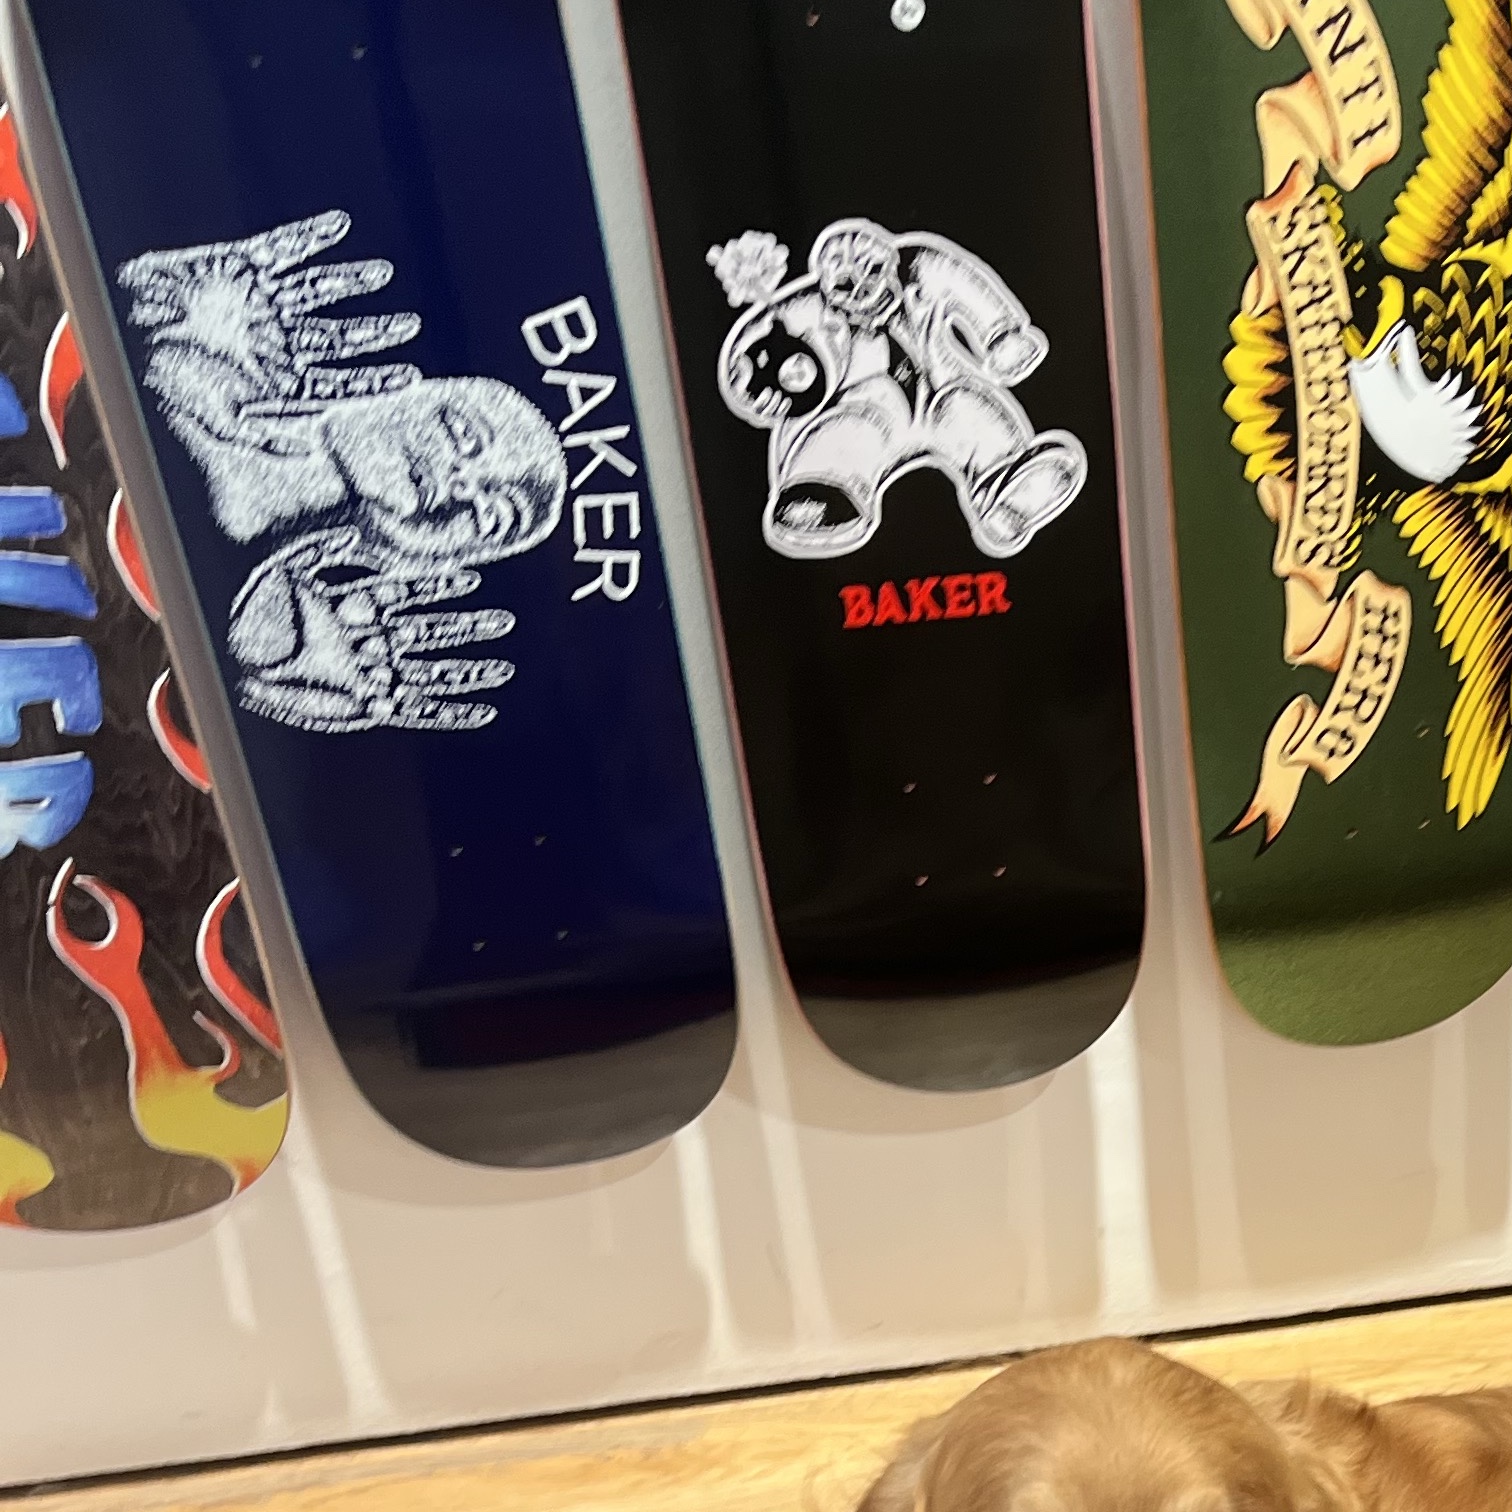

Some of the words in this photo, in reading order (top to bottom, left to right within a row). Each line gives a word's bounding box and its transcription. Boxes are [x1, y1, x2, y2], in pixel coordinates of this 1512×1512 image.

[1300, 0, 1392, 152] NTI
[520, 296, 641, 602] BAKER
[1268, 196, 1352, 569] SKATEBOARDS
[838, 571, 1013, 629] BAKER
[1313, 591, 1403, 763] HERO
